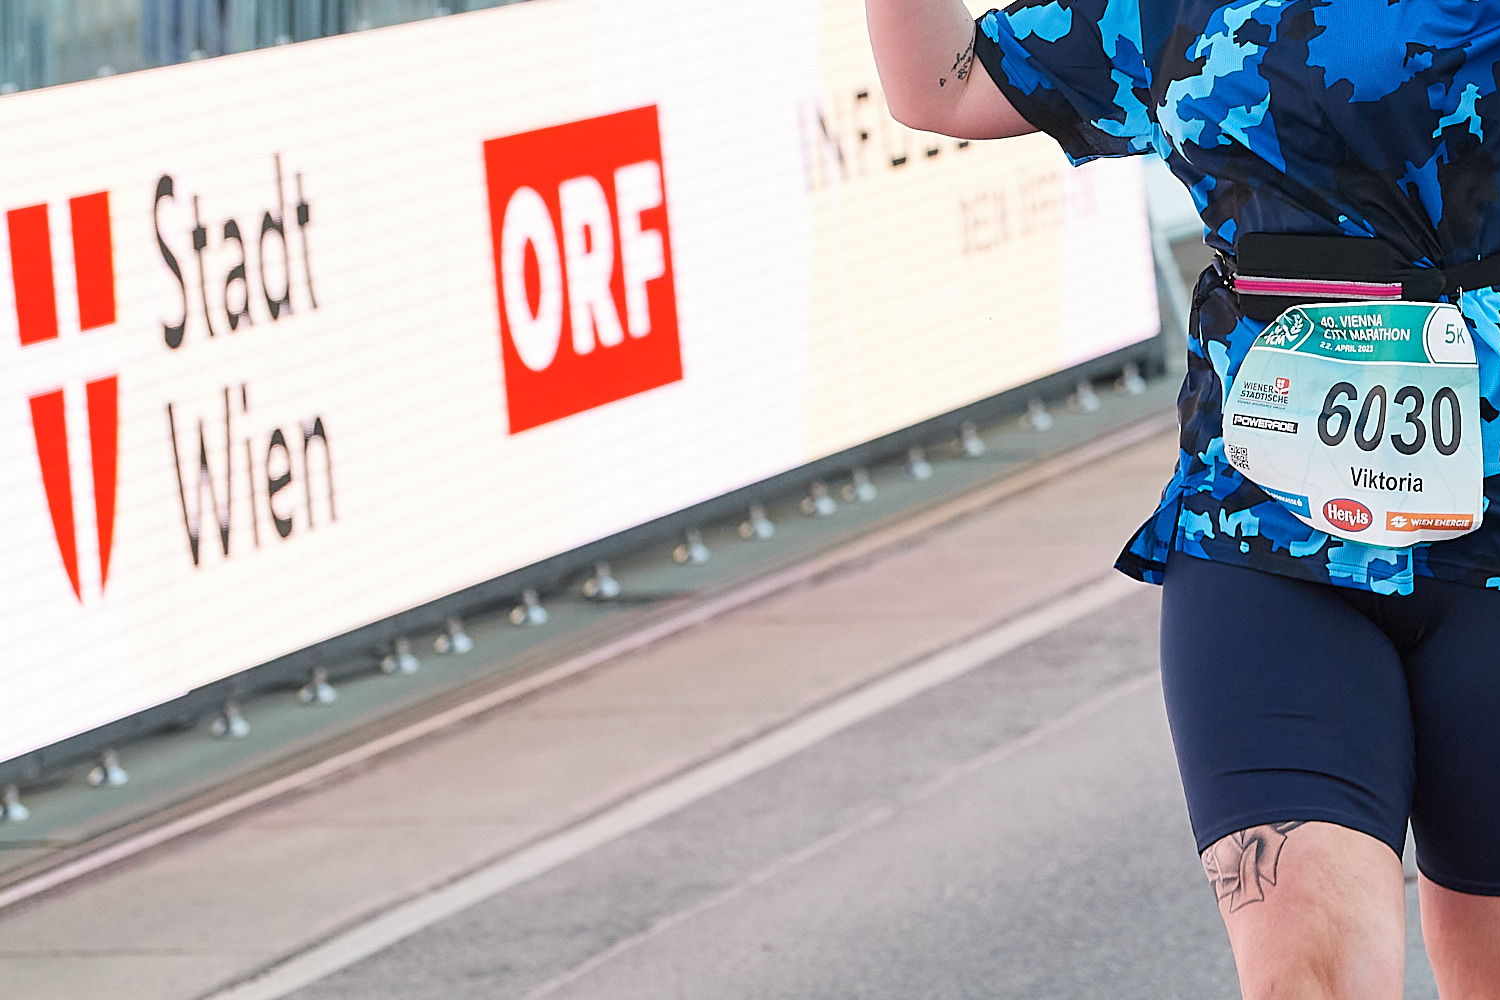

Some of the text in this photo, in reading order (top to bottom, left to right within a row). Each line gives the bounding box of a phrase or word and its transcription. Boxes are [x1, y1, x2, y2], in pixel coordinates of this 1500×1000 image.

[153, 153, 319, 351] Stadt
[502, 159, 667, 372] ORF
[1320, 314, 1382, 328] 40. VIENNA
[1323, 328, 1411, 341] CITY MARATHON
[1319, 341, 1374, 353] 22. APRIL 2023
[1244, 381, 1274, 394] WIENER
[1233, 415, 1295, 433] POWERADE
[1317, 381, 1462, 456] 6030
[167, 381, 338, 570] Wien
[1350, 466, 1424, 493] Viktoria
[1327, 503, 1369, 526] Hervis
[1411, 518, 1470, 527] WIEN ENERGIE
